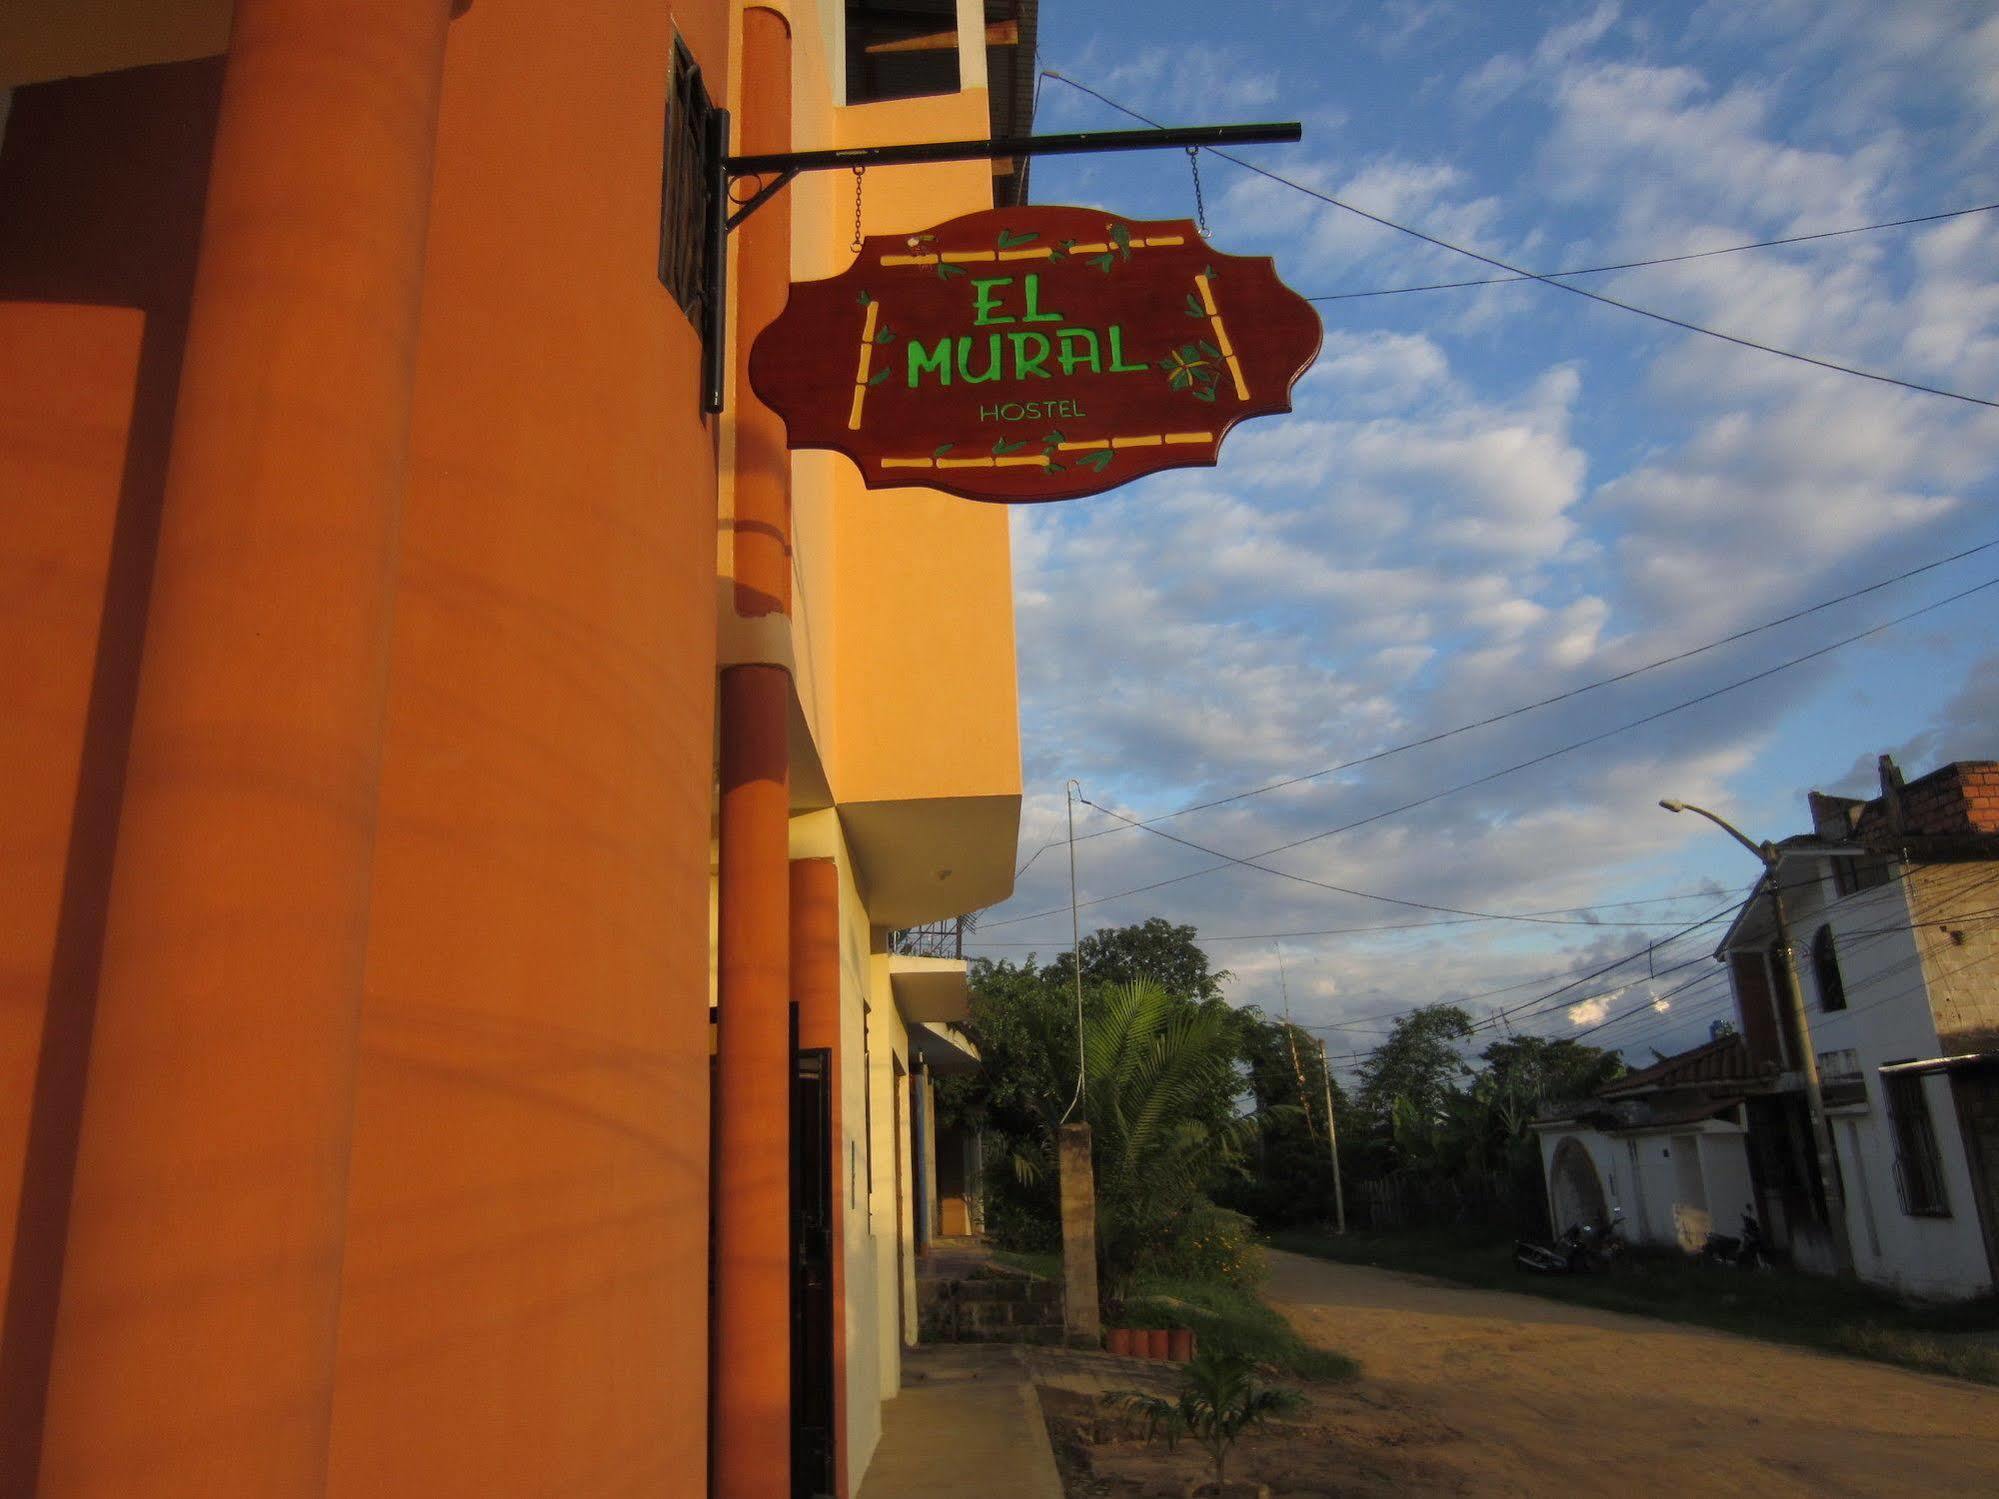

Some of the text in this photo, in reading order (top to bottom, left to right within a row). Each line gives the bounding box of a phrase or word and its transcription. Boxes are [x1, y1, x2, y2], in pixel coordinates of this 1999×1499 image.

[971, 274, 1063, 325] EL
[908, 325, 1149, 388] MURAL
[979, 400, 1087, 421] HOSTEL
